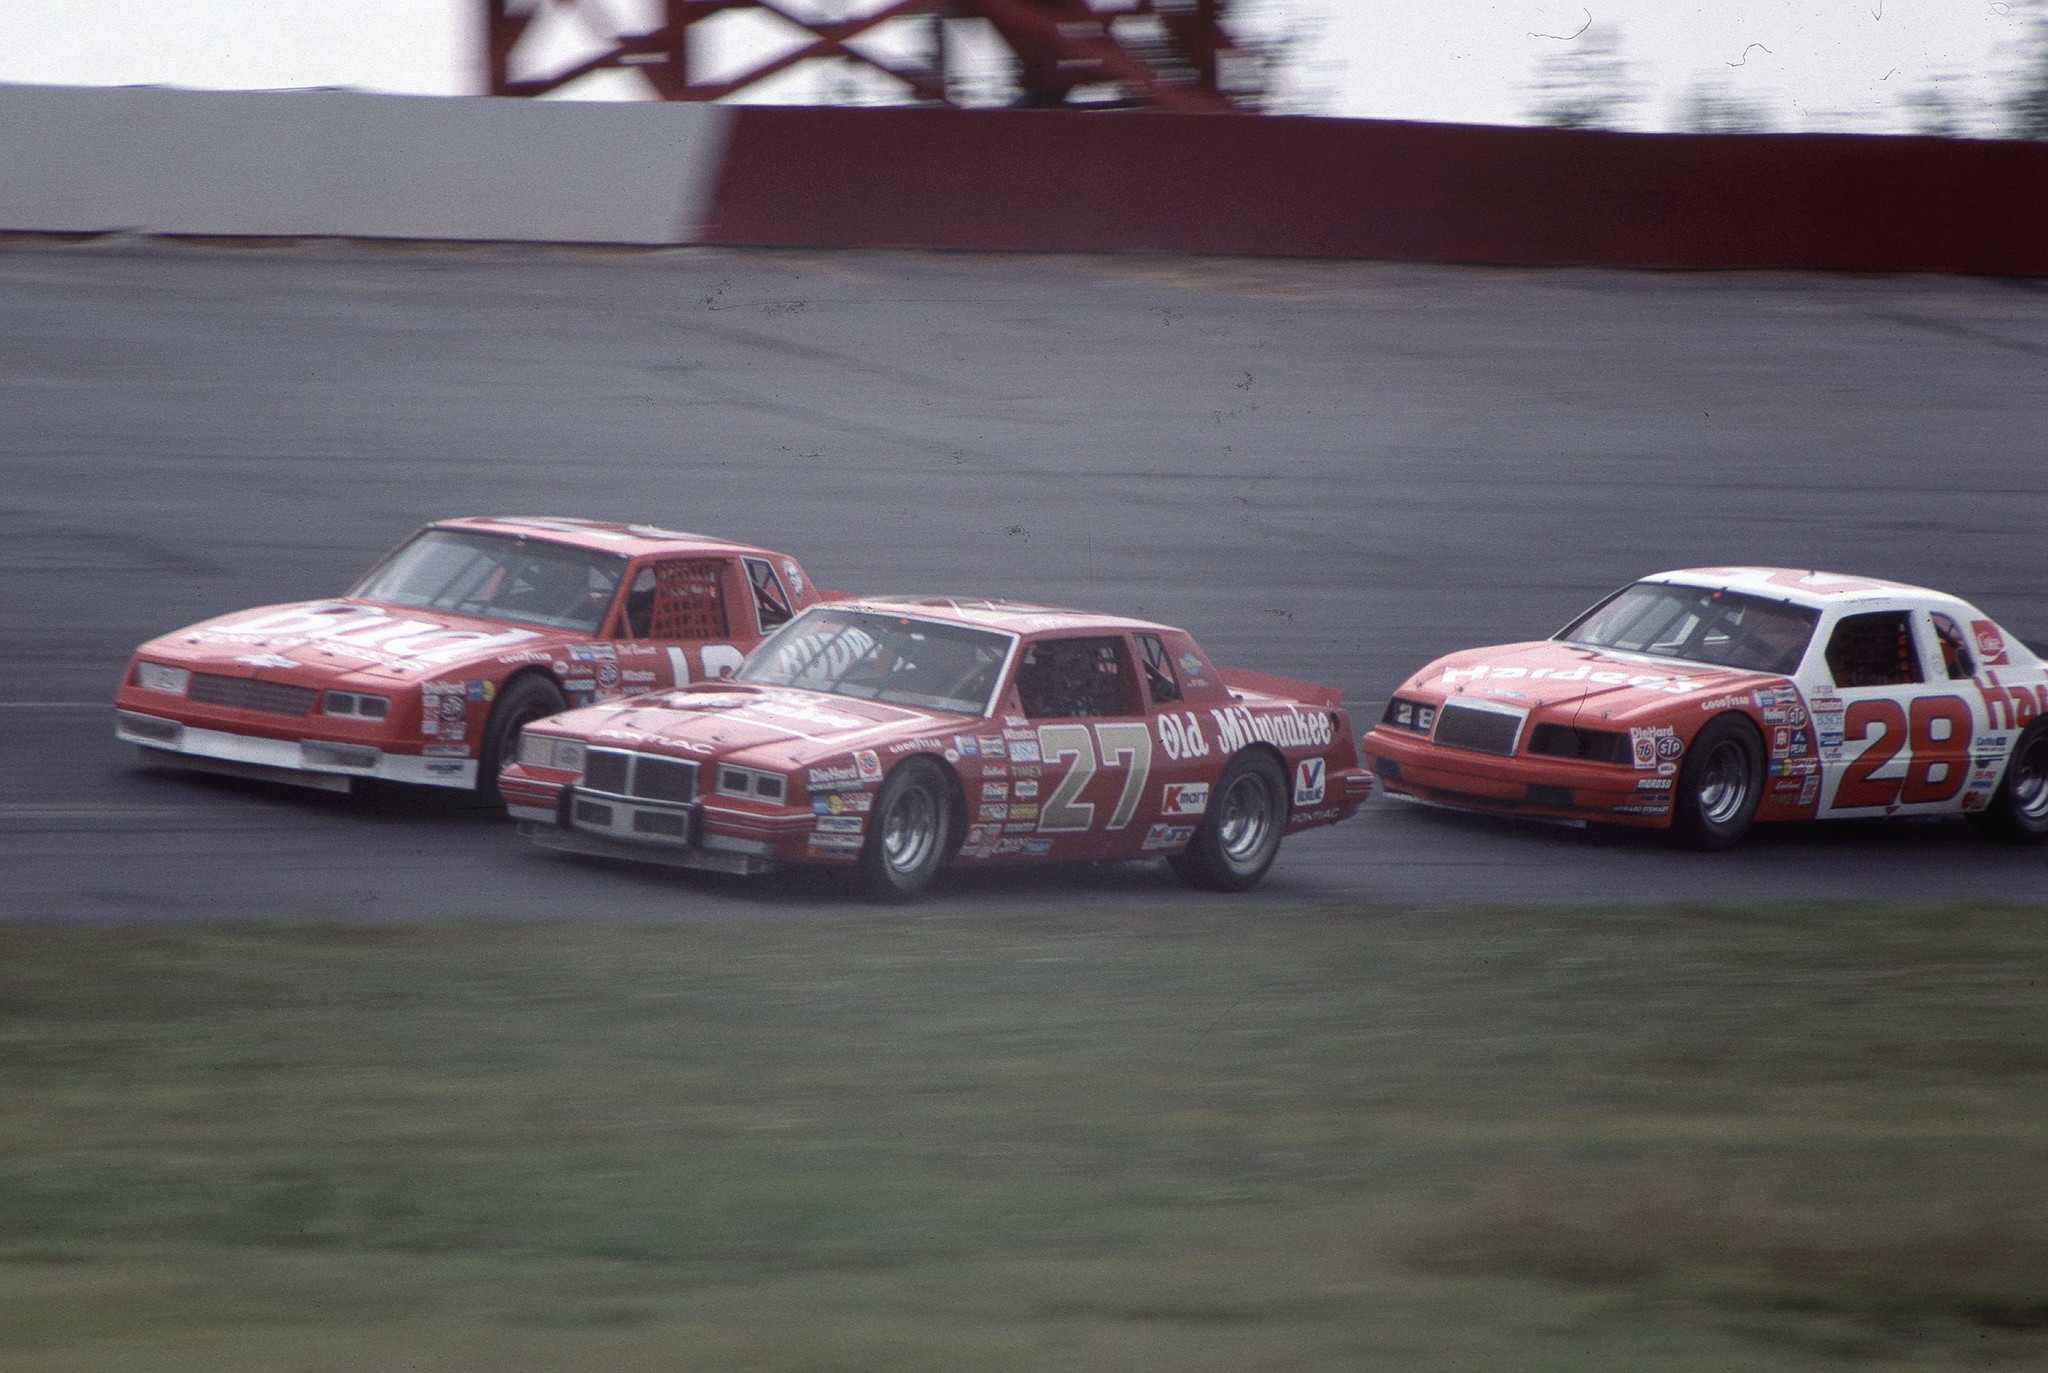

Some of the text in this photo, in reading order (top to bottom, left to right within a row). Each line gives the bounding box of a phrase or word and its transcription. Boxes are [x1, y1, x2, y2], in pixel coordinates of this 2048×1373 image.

[1442, 665, 1703, 694] Hardee's
[1701, 695, 1749, 711] GOODYEAR
[1397, 703, 1435, 729] 28
[1788, 707, 1805, 724] STP
[1157, 703, 1332, 760] Old Milwaukee
[1630, 725, 1674, 738] DieHard
[1639, 743, 1651, 756] 76
[1660, 739, 1681, 755] STP
[1790, 744, 1808, 754] PEAK
[1829, 694, 1973, 809] 28
[1037, 722, 1152, 833] 27
[1638, 779, 1673, 789] MOROSO
[1291, 807, 1341, 823] PONTIAC
